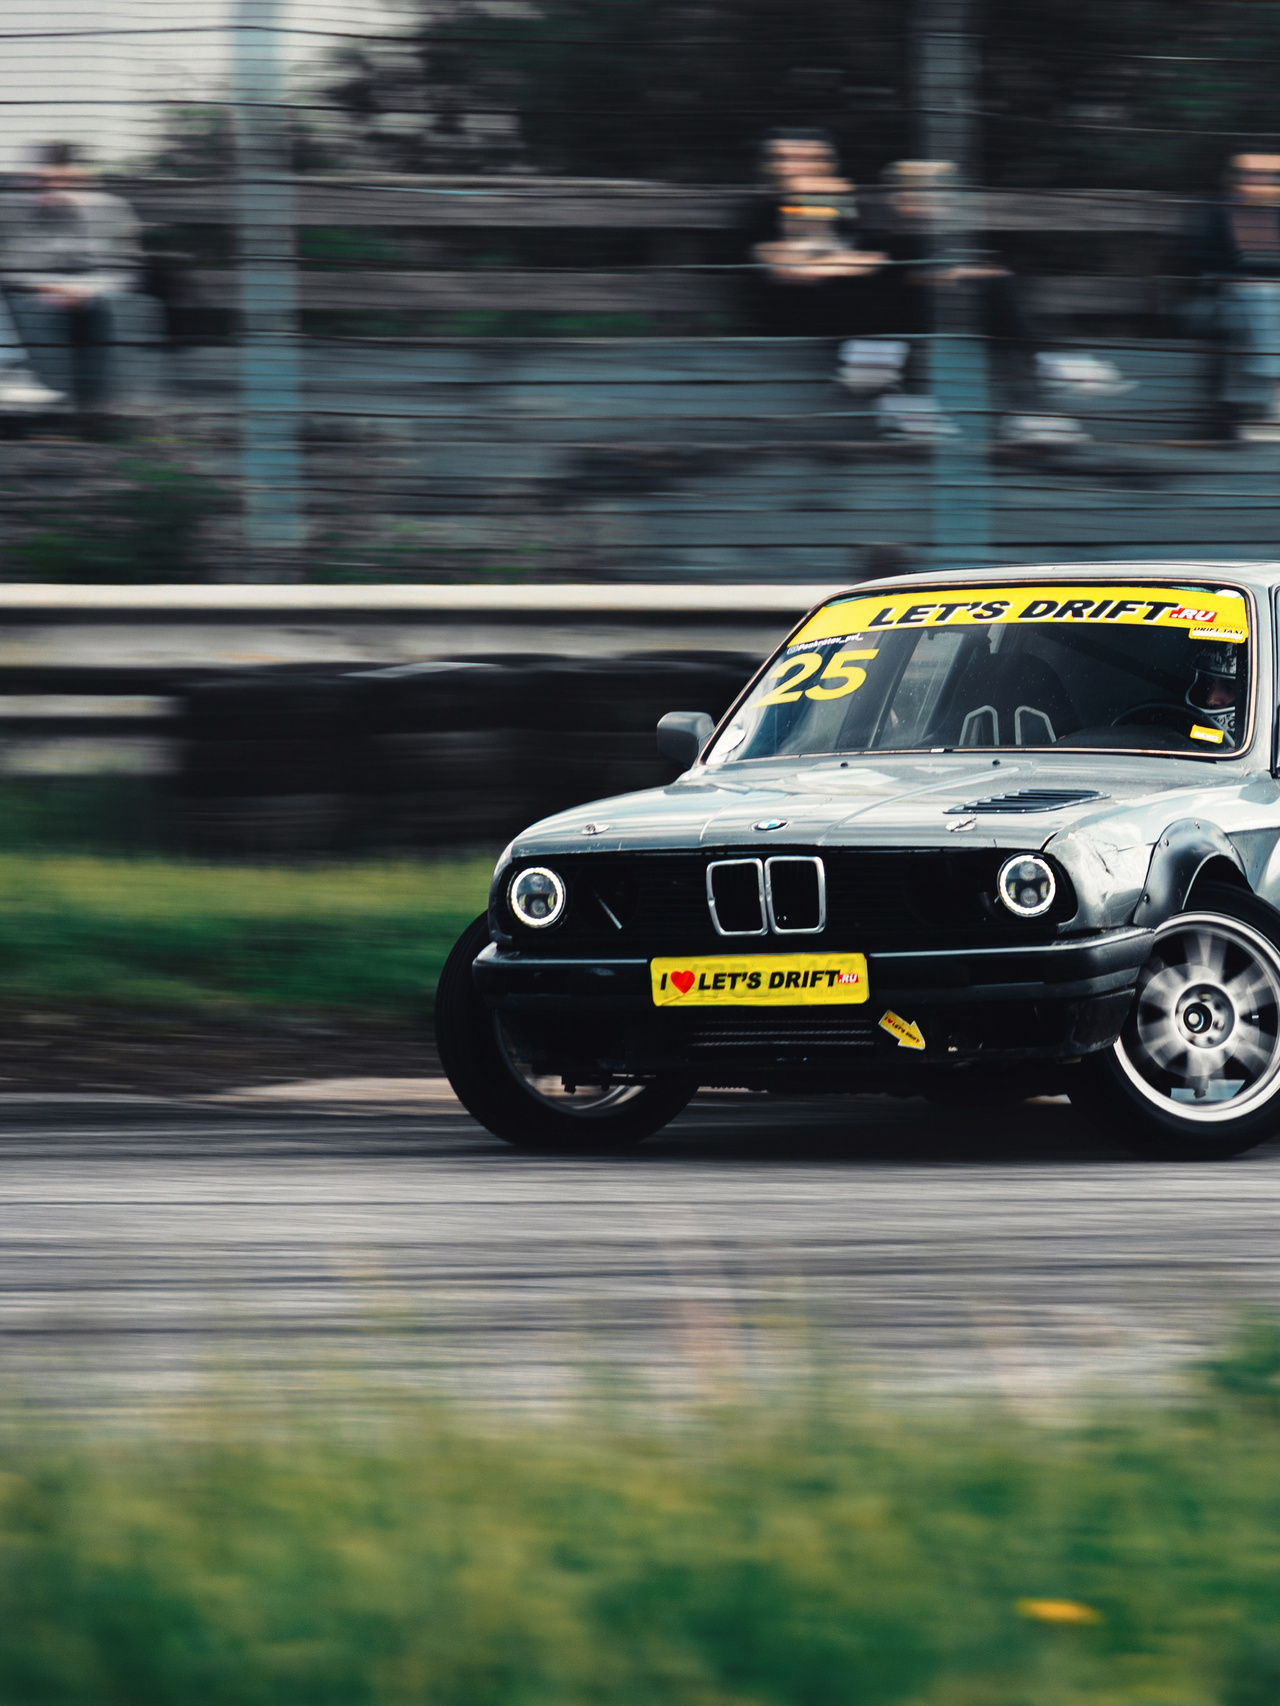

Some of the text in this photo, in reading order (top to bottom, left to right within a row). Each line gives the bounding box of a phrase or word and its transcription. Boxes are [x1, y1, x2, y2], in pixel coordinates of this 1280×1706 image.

[867, 600, 1013, 629] LET'S
[749, 648, 880, 710] 25
[660, 972, 668, 991] I
[697, 972, 762, 991] LET'S
